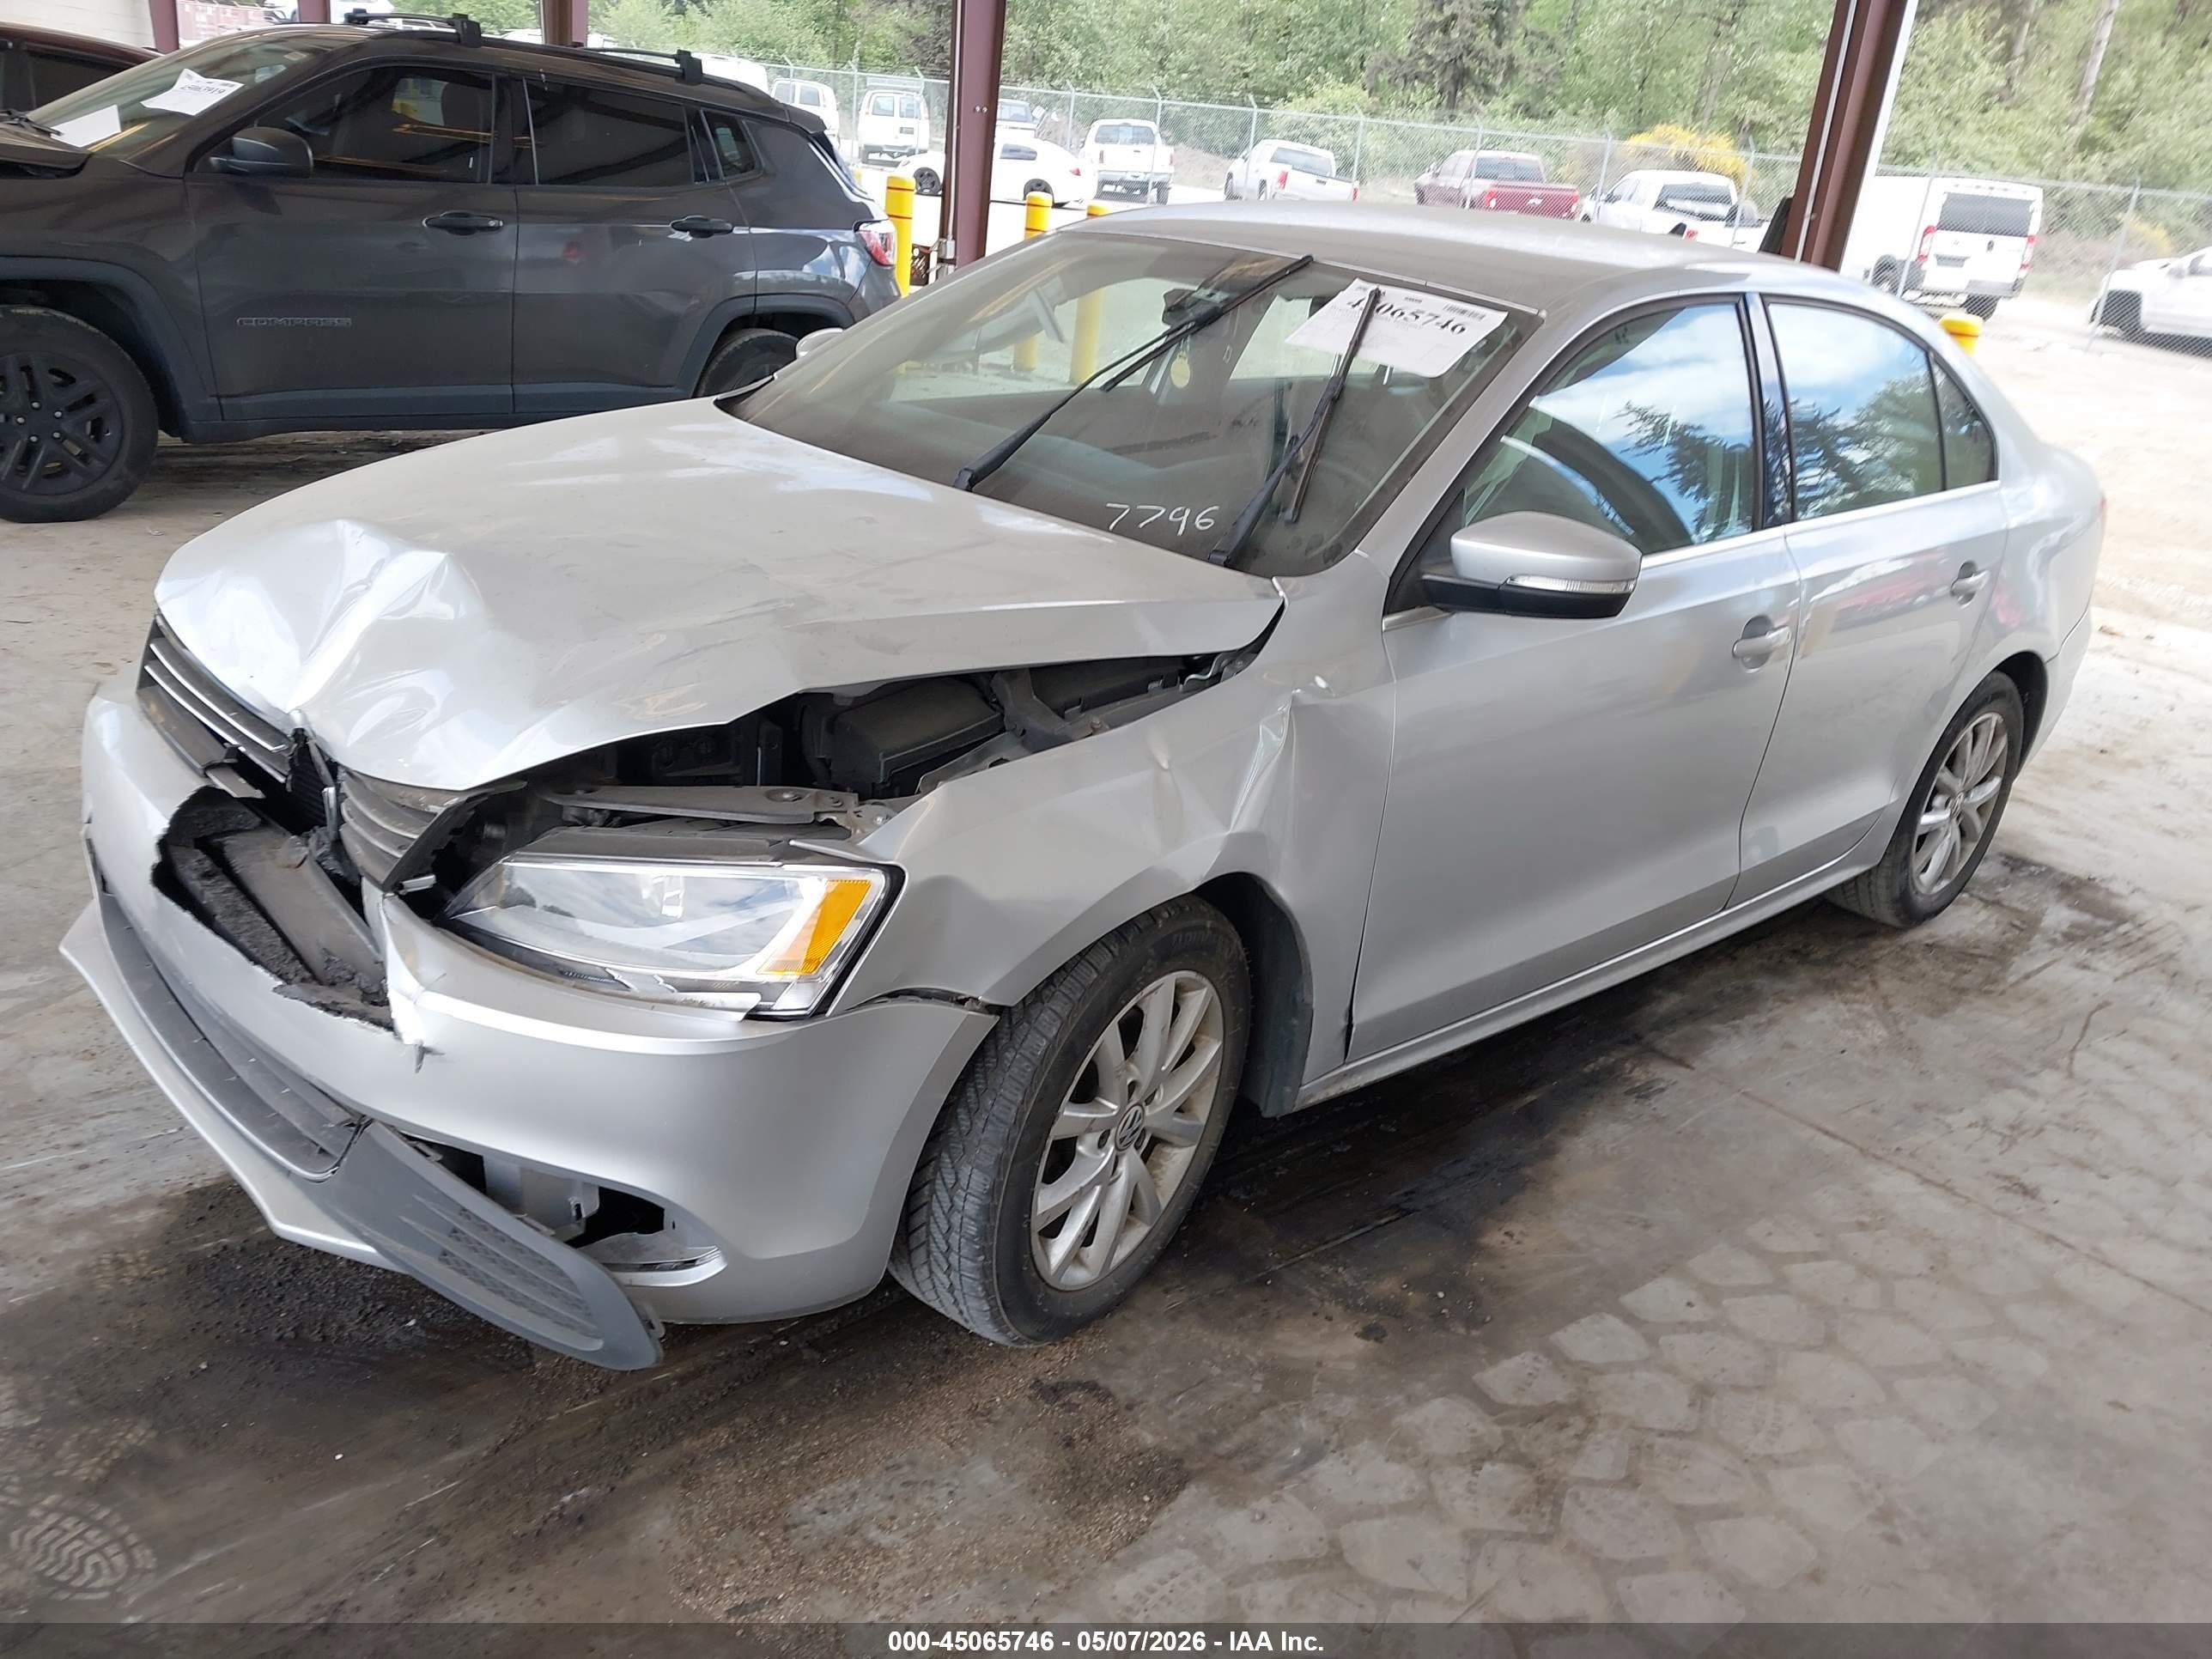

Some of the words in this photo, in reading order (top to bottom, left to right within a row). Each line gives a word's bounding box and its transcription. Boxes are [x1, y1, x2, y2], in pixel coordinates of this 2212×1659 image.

[236, 316, 353, 327] COMPASS
[1346, 296, 1467, 334] 4065746
[1106, 502, 1219, 536] 7796
